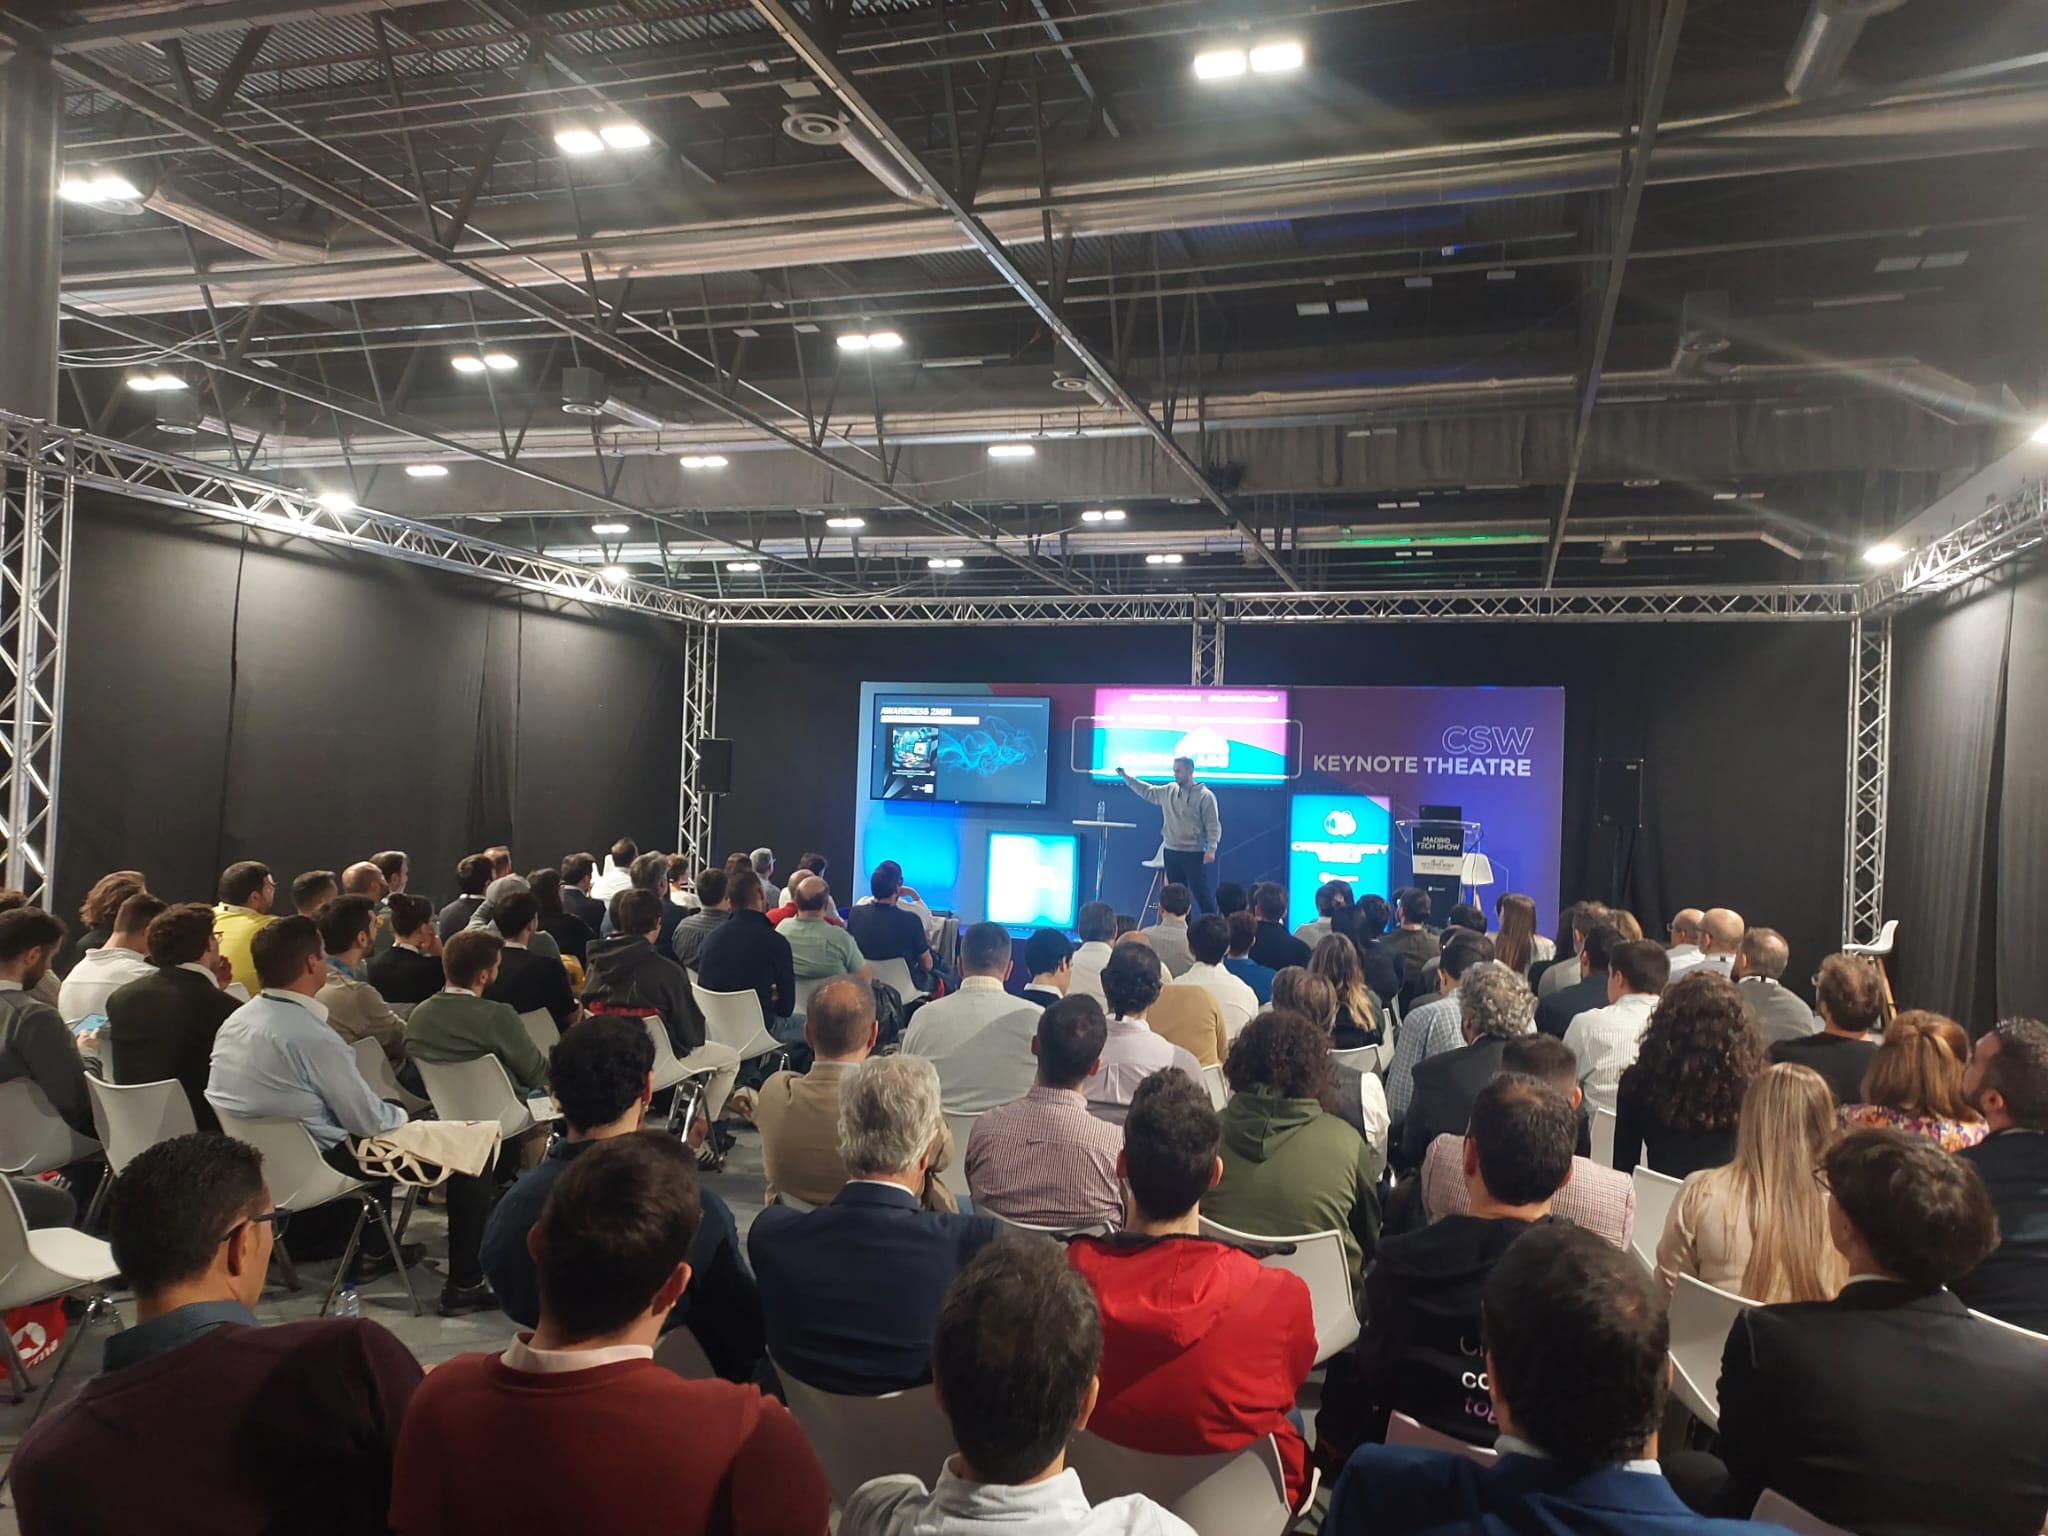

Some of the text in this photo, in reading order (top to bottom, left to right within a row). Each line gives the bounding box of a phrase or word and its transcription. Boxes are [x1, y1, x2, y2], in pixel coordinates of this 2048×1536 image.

[880, 706, 929, 716] AWARENESS
[1442, 725, 1534, 756] CSW
[1313, 755, 1532, 777] KEYNOTE THEATRE
[1422, 836, 1451, 844] MADRID
[1416, 842, 1460, 851] TECH SHOW
